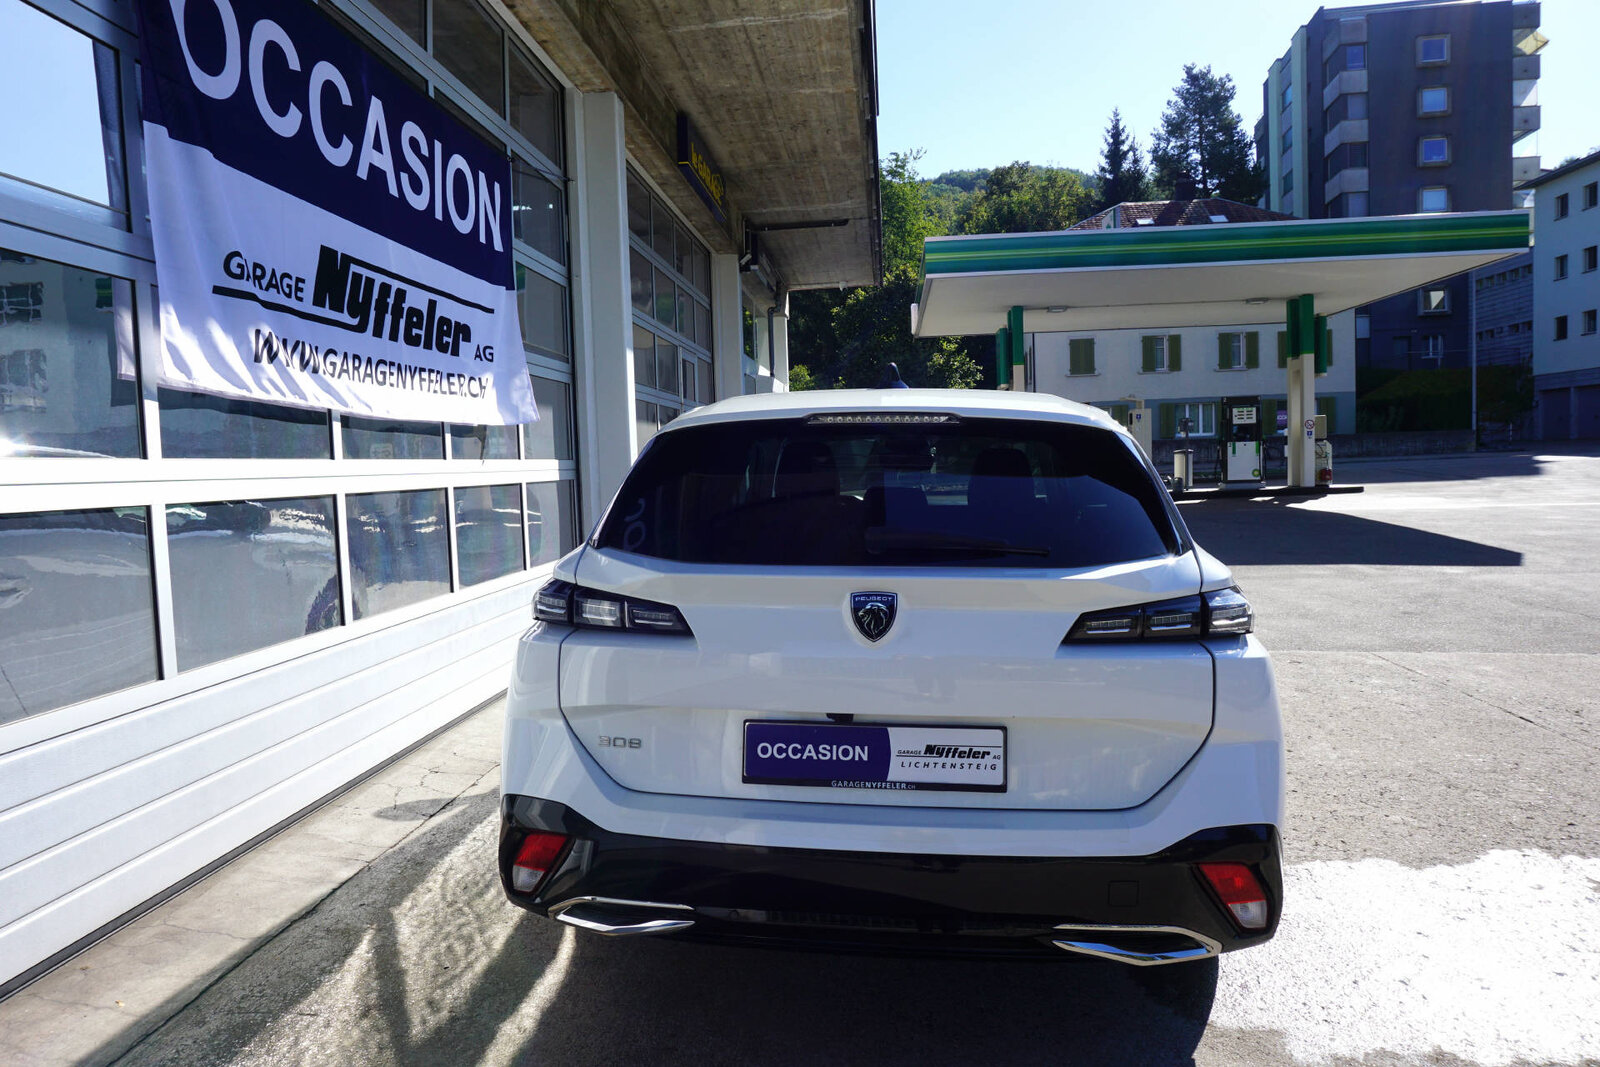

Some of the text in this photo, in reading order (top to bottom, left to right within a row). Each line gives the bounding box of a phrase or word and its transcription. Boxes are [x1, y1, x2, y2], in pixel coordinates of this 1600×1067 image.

[169, 0, 504, 252] OCCASION
[223, 244, 495, 363] GARAGE Nyffeler AG
[598, 735, 642, 749] 308
[757, 742, 869, 762] OCCASION
[924, 744, 991, 760] Nyffeler
[900, 761, 997, 771] LICHTENSTEIG
